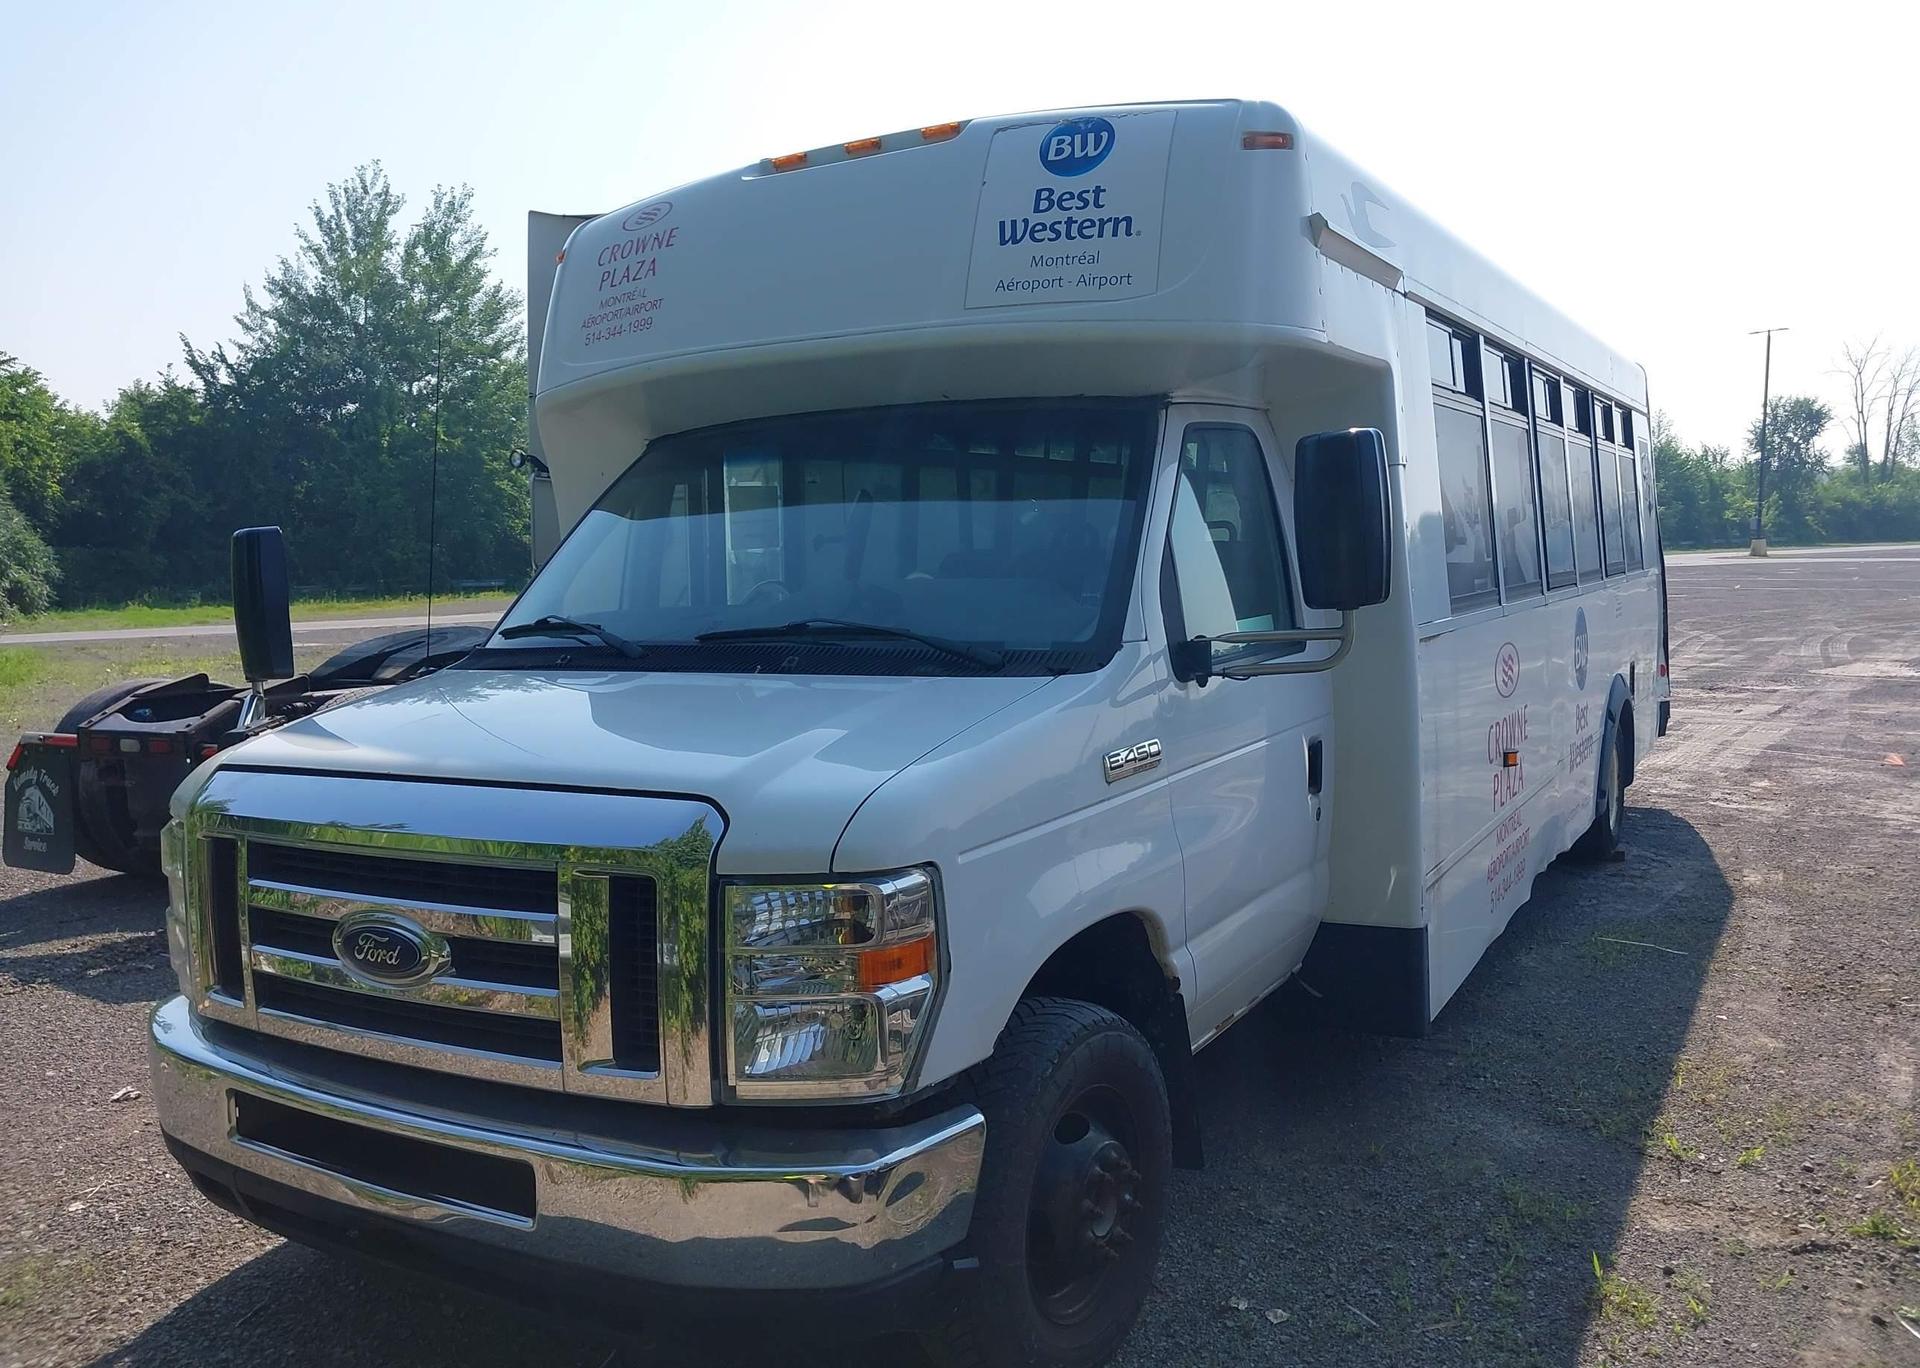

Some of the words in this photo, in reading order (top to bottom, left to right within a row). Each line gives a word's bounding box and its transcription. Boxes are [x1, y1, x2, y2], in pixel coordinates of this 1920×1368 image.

[1047, 131, 1109, 161] BW
[1032, 185, 1107, 214] Best
[998, 214, 1134, 246] Western
[597, 226, 680, 267] CROWNE
[1030, 250, 1101, 268] Montréal
[599, 257, 656, 292] PLAZA
[995, 275, 1064, 293] Aéroport
[1075, 272, 1133, 290] Airport
[584, 317, 654, 346] 514-344-1999
[1575, 701, 1589, 735] Best
[1487, 704, 1529, 765] CROWNE
[39, 768, 61, 797] Truck
[1493, 756, 1525, 813] PLAZA
[354, 932, 401, 966] Ford
